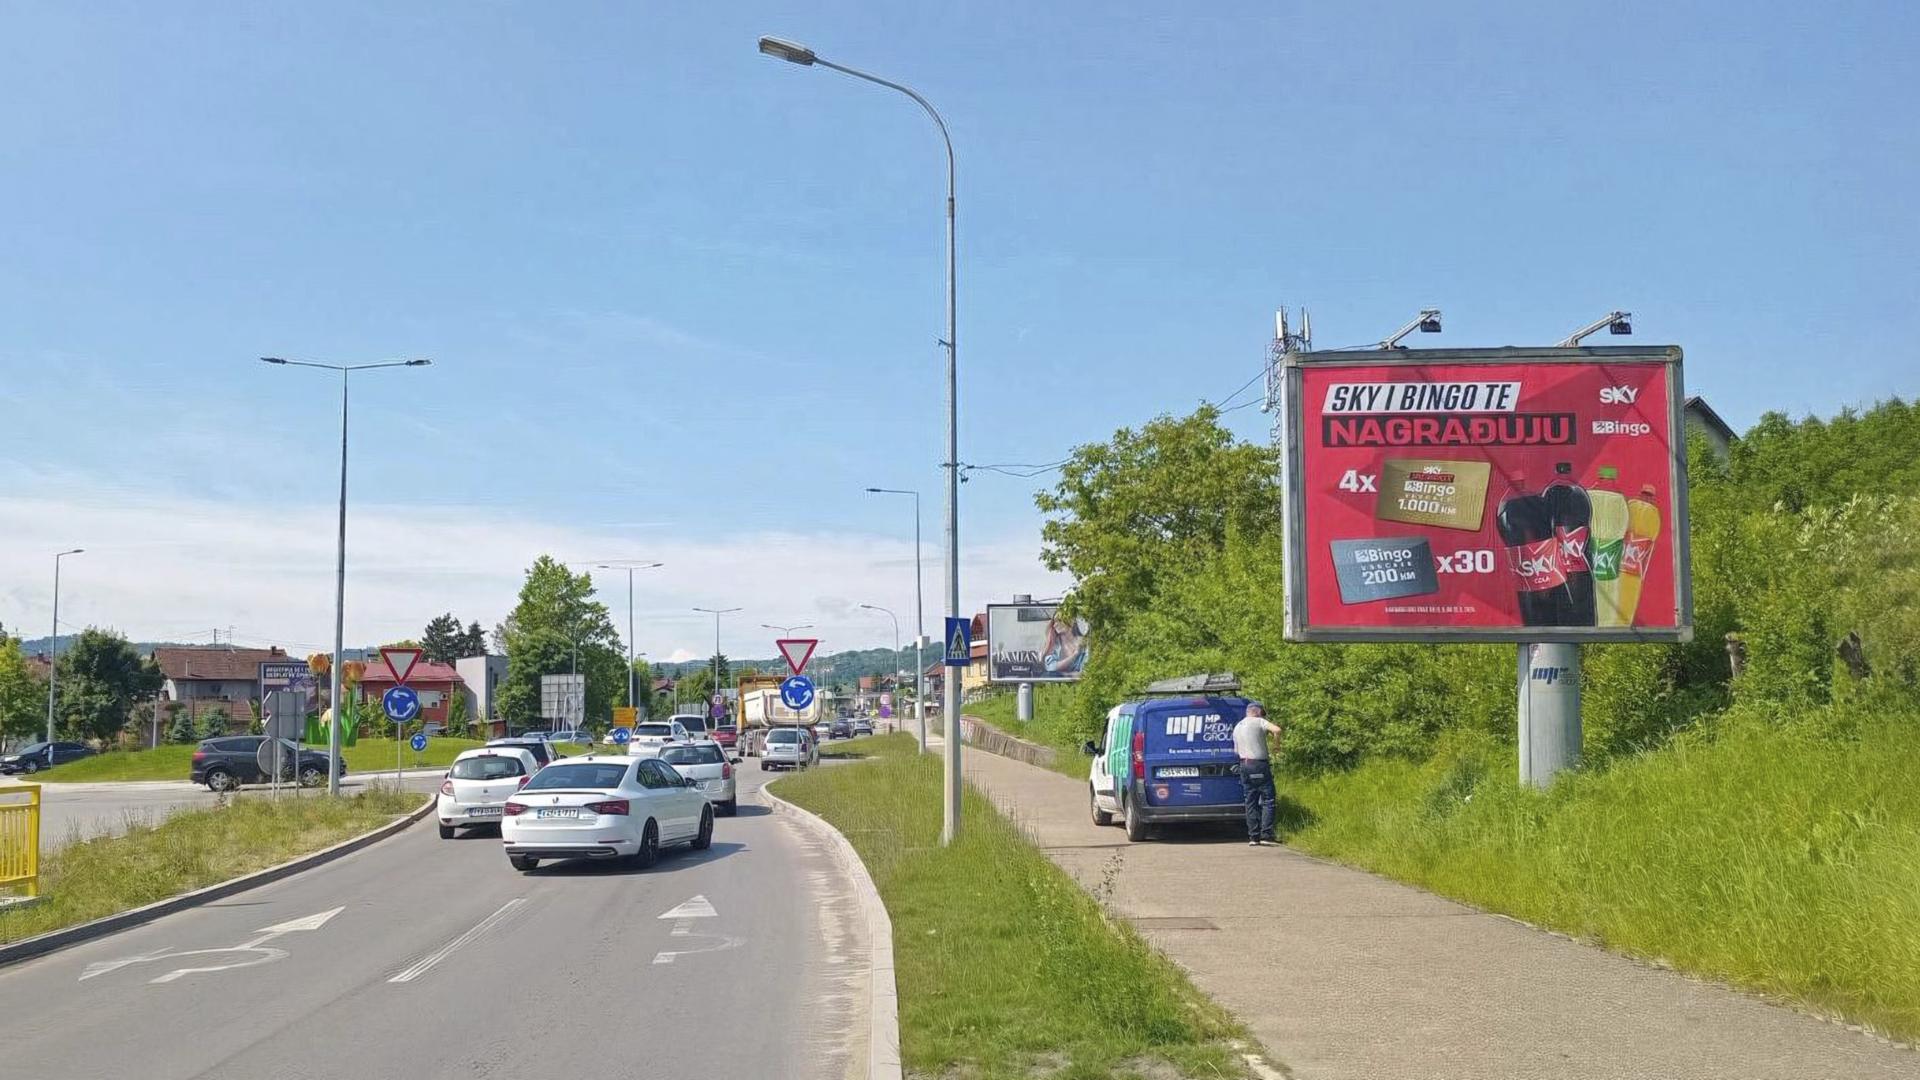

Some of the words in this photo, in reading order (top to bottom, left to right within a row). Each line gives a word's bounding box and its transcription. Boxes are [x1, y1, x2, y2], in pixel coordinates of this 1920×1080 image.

[1332, 384, 1380, 411] SKY
[1384, 385, 1395, 411] I
[1400, 383, 1476, 411] BINGO
[1485, 383, 1512, 410] TE
[1599, 385, 1639, 404] SKY
[1330, 416, 1570, 446] NAGRAĐUJU
[1605, 420, 1650, 436] Bingo
[1338, 469, 1377, 493] 4x
[1415, 481, 1456, 497] Bingo
[1397, 499, 1440, 514] 1.000
[1368, 548, 1412, 562] Bingo
[1436, 550, 1495, 573] x30
[1521, 554, 1555, 577] SKY
[1362, 568, 1399, 585] 200
[1400, 571, 1416, 581] KM
[1205, 714, 1221, 723] MP
[1203, 732, 1233, 742] GROU
